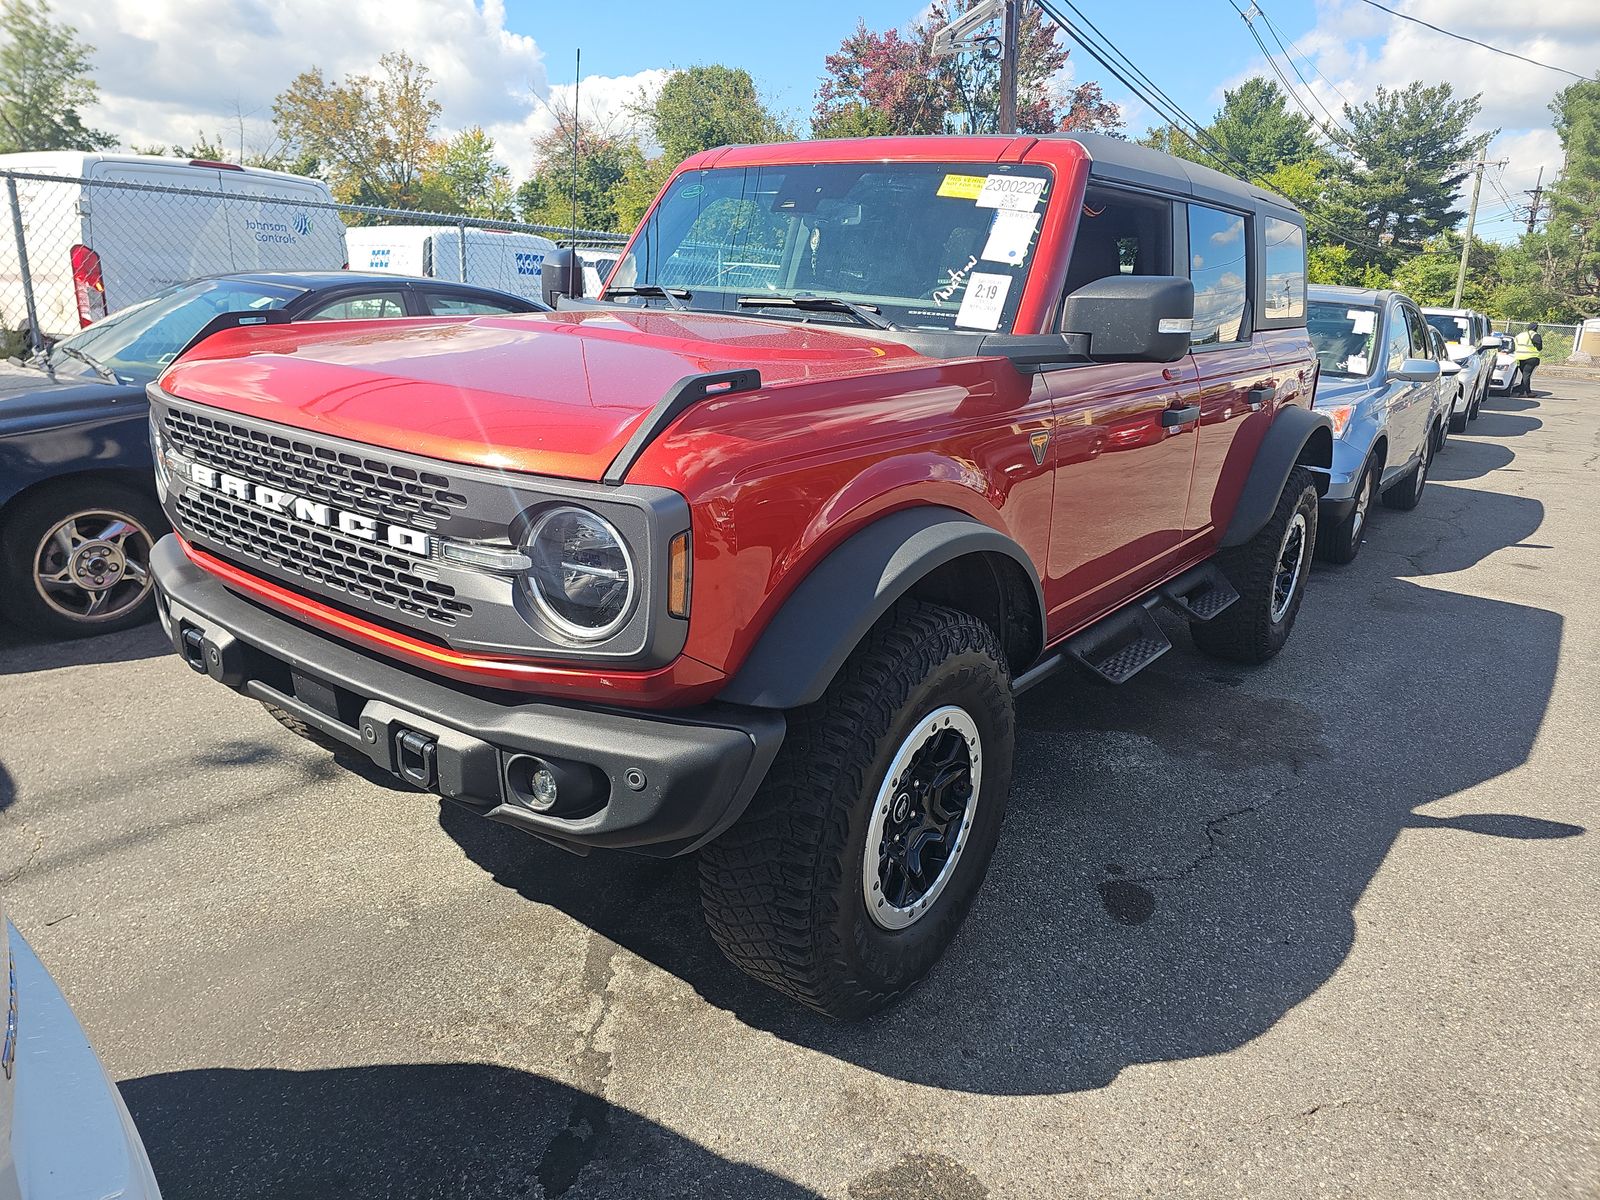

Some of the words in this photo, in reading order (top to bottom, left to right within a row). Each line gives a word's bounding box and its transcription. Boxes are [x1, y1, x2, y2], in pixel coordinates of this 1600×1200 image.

[985, 178, 1043, 195] 2300220
[245, 219, 287, 232] Johnson
[255, 232, 297, 244] Controls
[975, 283, 998, 300] 2:19
[191, 463, 431, 557] BRONCO
